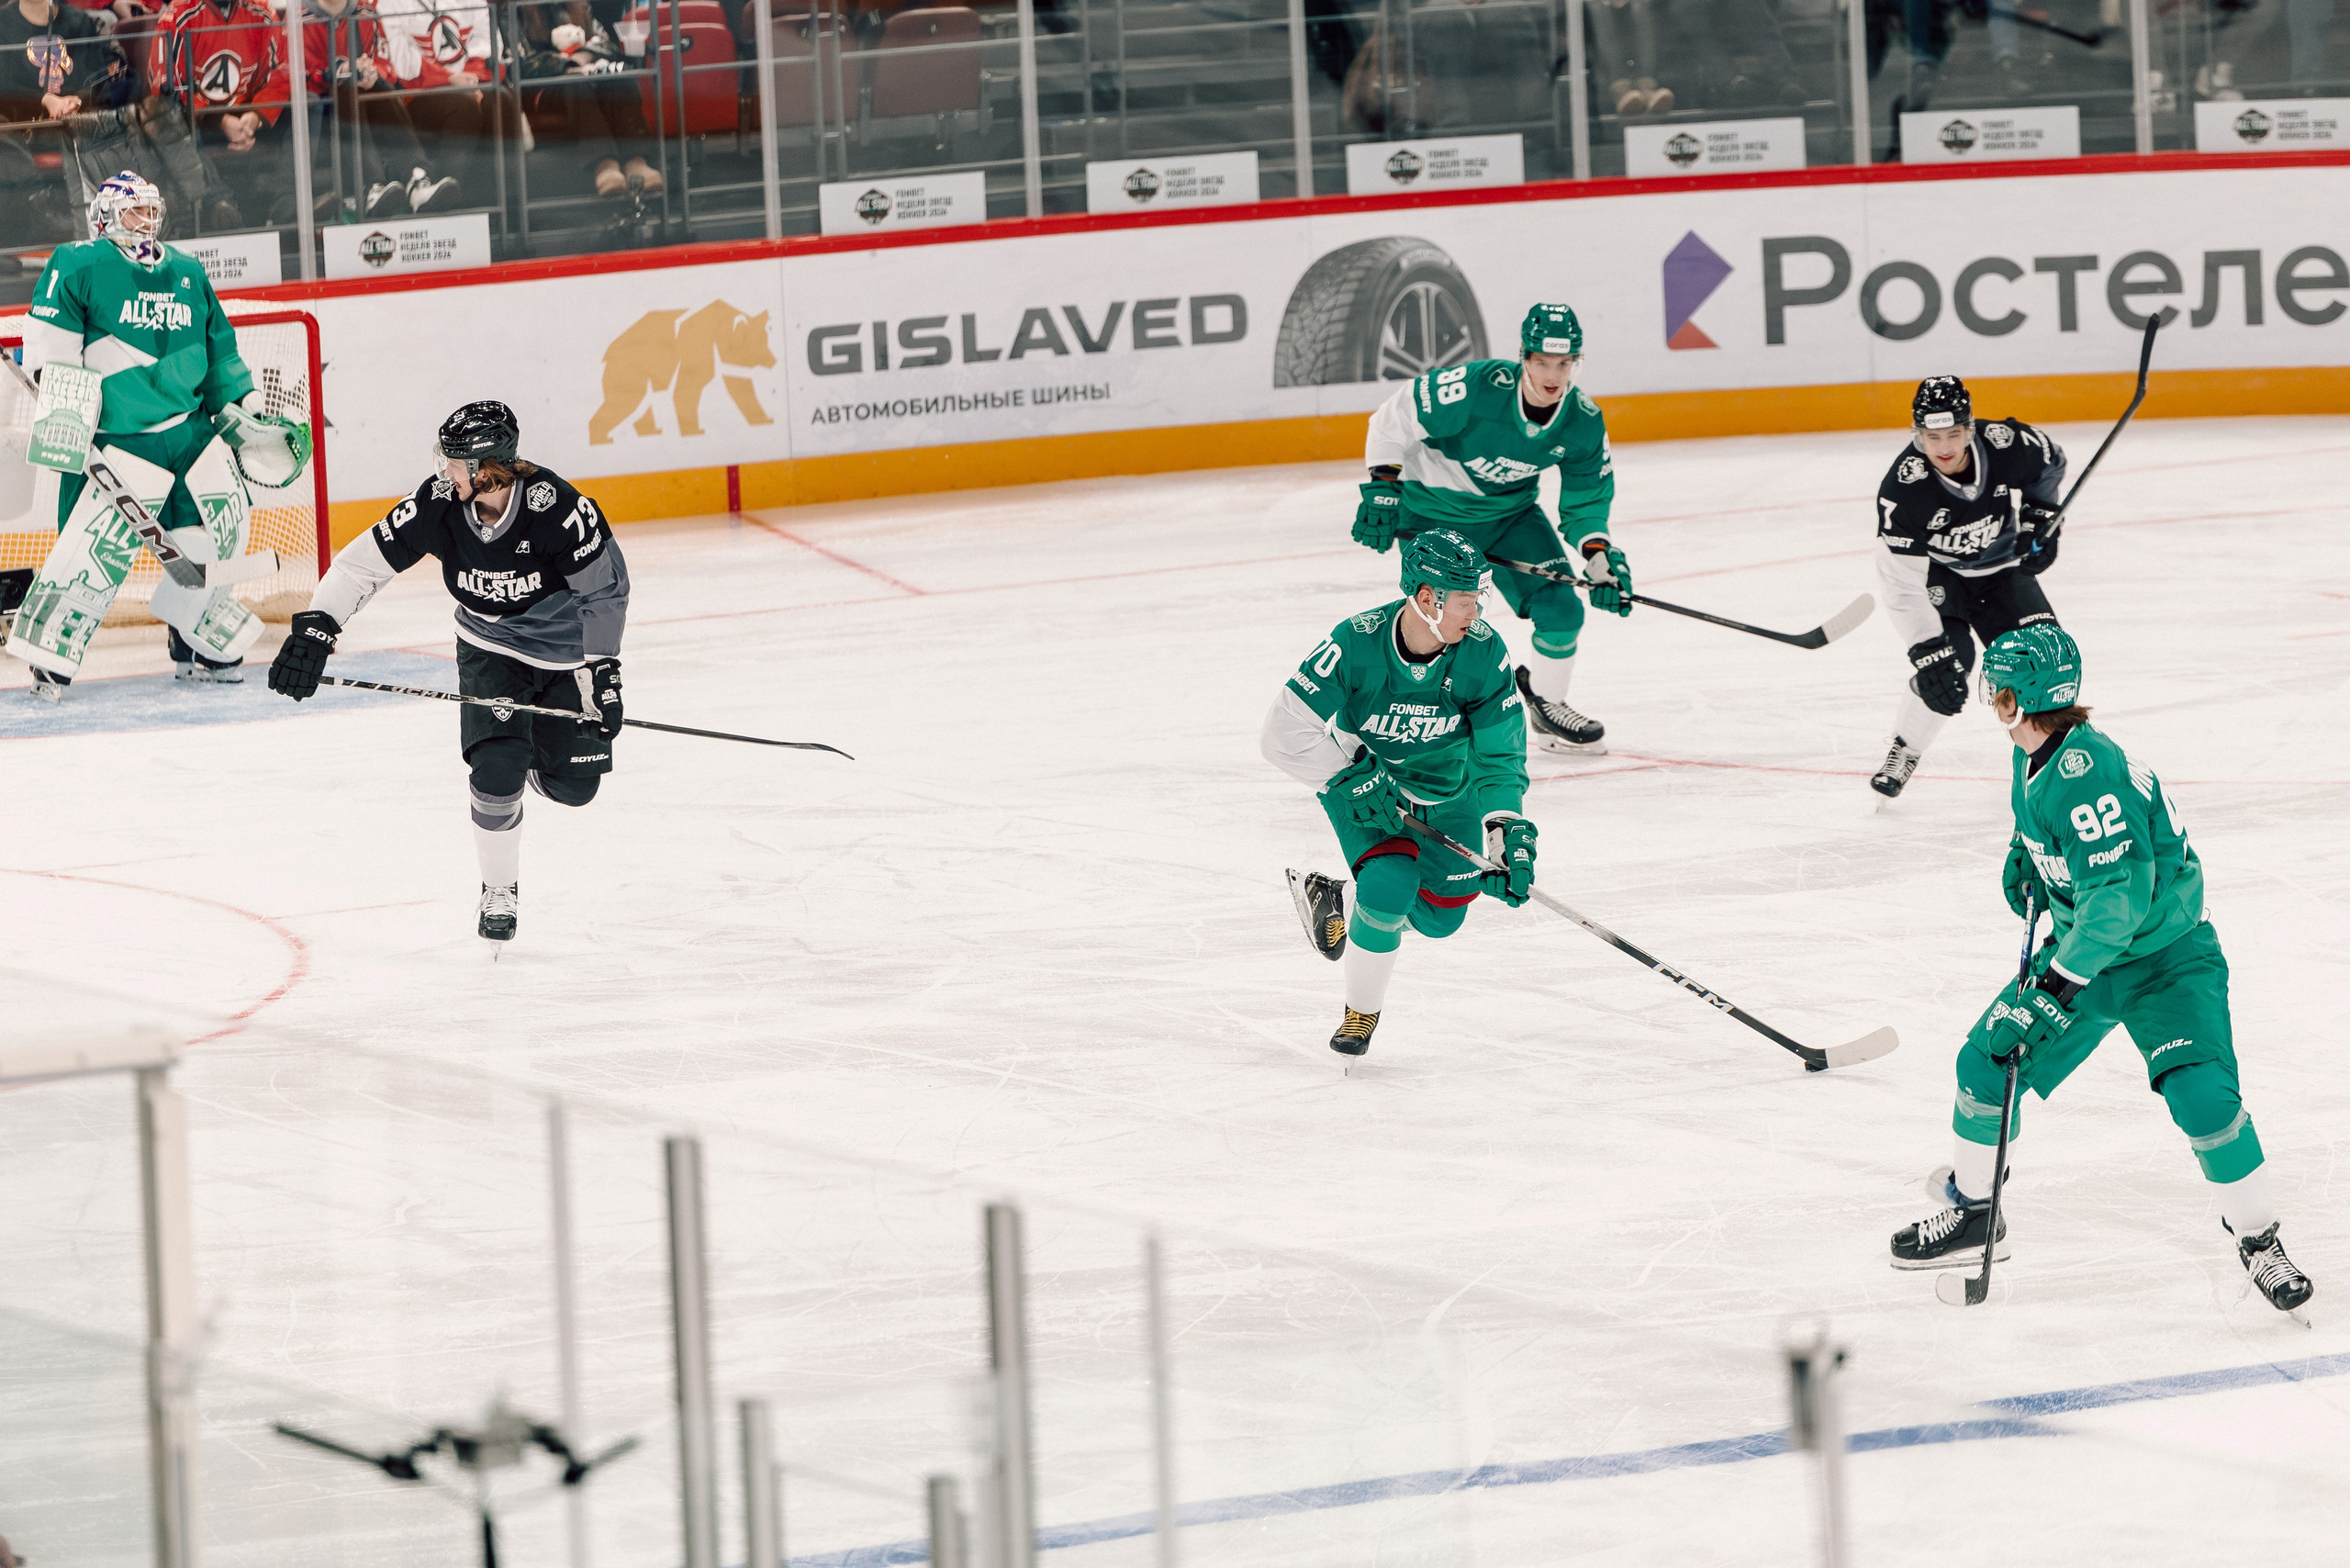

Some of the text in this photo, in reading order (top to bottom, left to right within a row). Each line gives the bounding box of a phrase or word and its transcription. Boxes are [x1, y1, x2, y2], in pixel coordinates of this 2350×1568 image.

[192, 249, 218, 258] ONBET
[201, 260, 220, 270] ДЕЛЯ
[47, 269, 59, 298] 1
[139, 291, 175, 303] FONBET
[807, 294, 1248, 375] GISLAVED
[811, 382, 1111, 425] АВТОМОБИЛЬНЫЕ ШИНЫ
[1494, 456, 1539, 474] FONBET
[89, 463, 184, 564] CCM
[562, 496, 598, 543] 73
[1879, 497, 1897, 530] 7
[1950, 514, 1993, 536] FONBET
[573, 527, 602, 562] FONBET
[457, 571, 543, 598] ALL STAR
[472, 568, 516, 580] FONBET
[1305, 638, 1342, 678] 70
[1915, 645, 1956, 669] SOYUZ
[1292, 671, 1320, 695] NBET
[1389, 703, 1439, 716] FONBET
[1360, 714, 1461, 738] ALL STAR
[570, 753, 605, 763] SOYUZ
[2070, 793, 2126, 842] 92
[2088, 839, 2132, 868] FONBET
